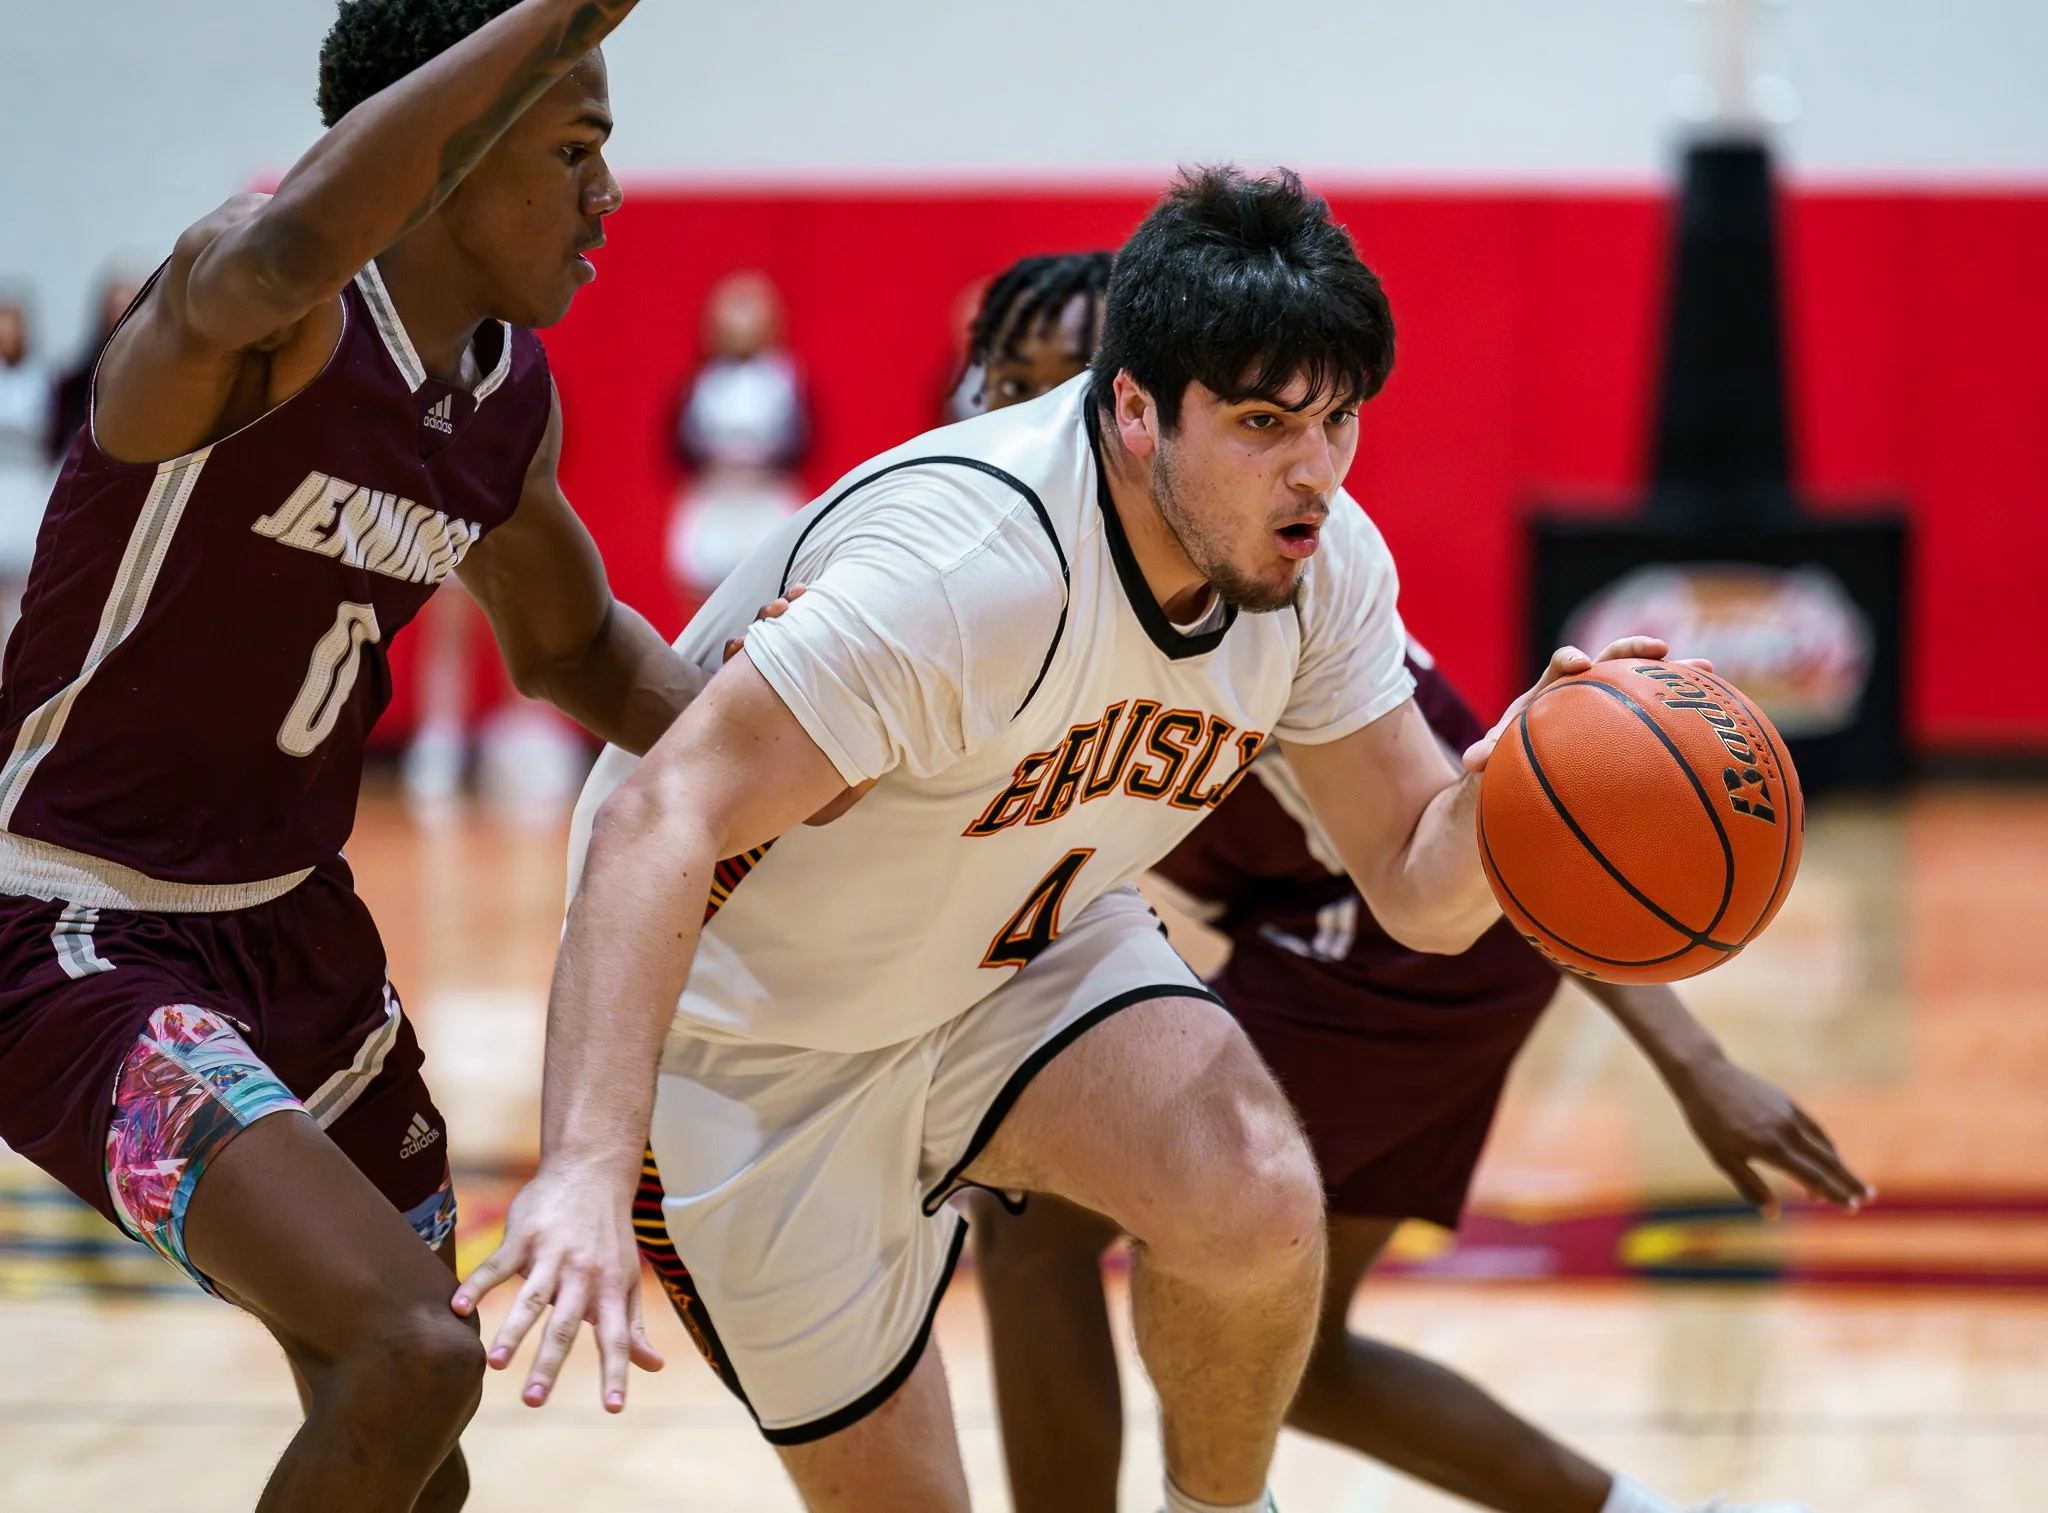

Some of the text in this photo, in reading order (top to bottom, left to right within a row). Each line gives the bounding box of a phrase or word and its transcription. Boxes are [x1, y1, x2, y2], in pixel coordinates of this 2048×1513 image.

[423, 415, 453, 434] adidas
[276, 600, 381, 758] 0
[977, 847, 1097, 971] 4
[399, 1128, 440, 1159] adidas
